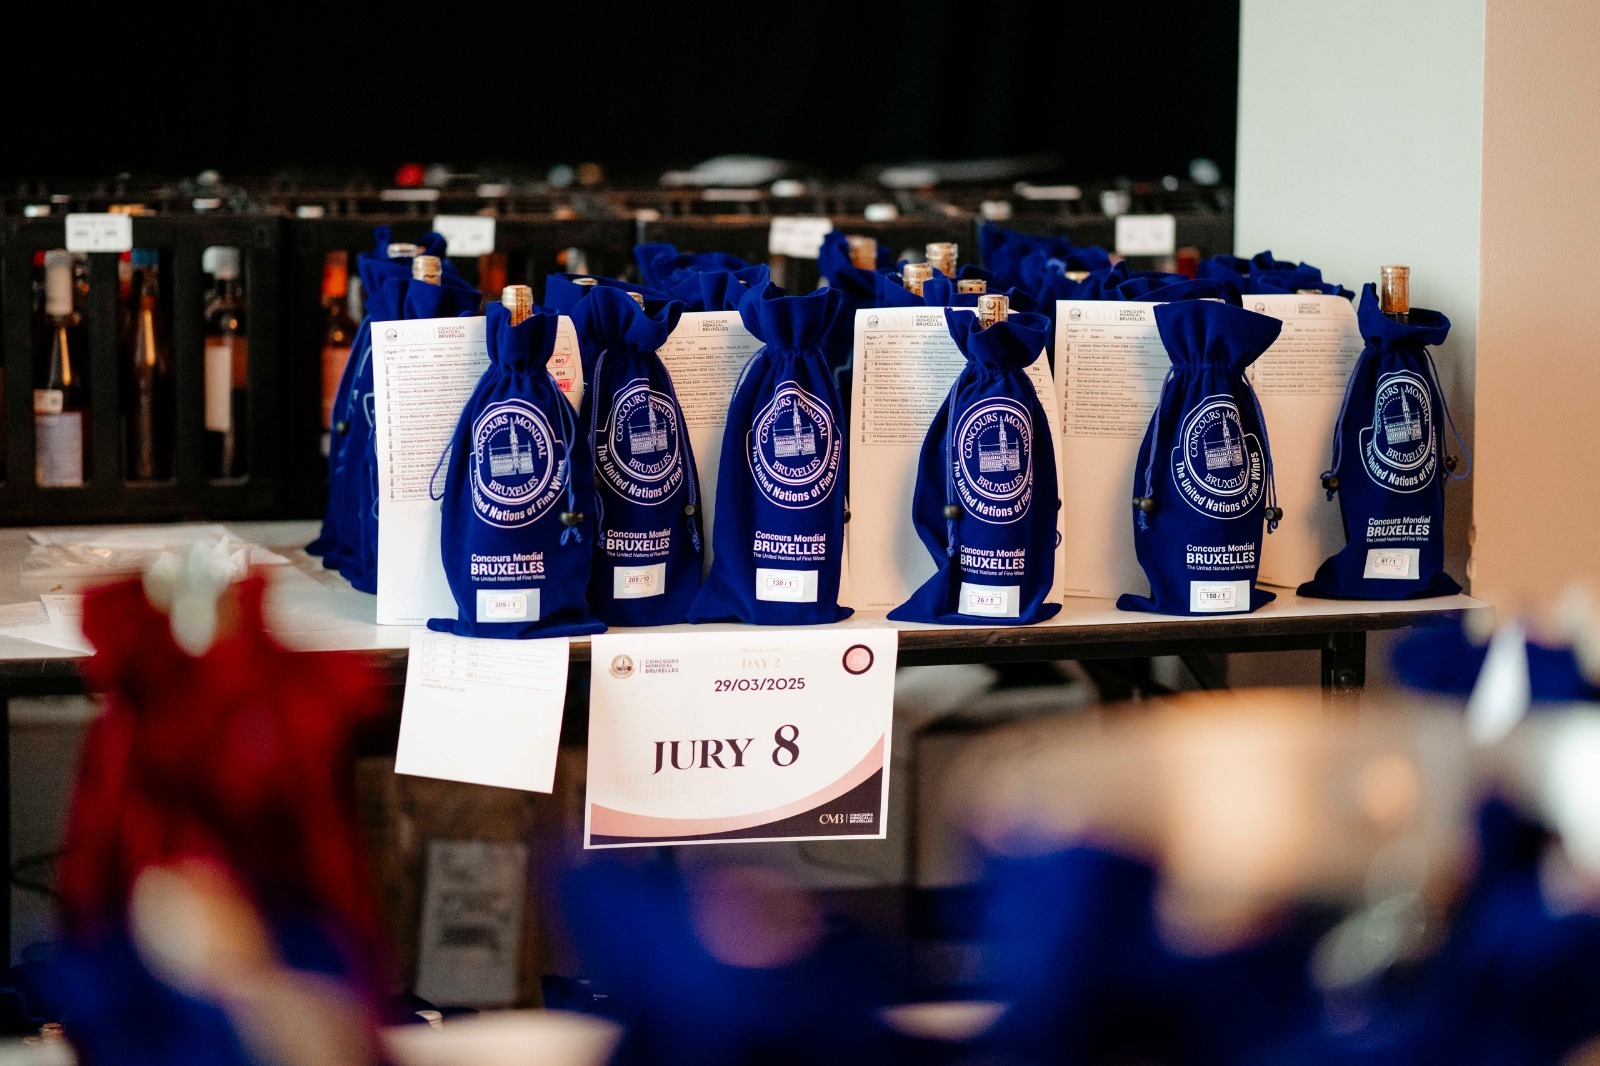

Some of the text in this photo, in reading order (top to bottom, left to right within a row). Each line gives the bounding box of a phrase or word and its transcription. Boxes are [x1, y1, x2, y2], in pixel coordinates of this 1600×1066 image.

[1404, 384, 1430, 425] MONDIAL
[616, 392, 646, 442] CONCOURS
[651, 402, 676, 435] ONDIAL
[478, 414, 509, 465] CONCOURS
[514, 415, 547, 459] MONDIAL
[964, 412, 998, 459] CONCOURS
[1004, 413, 1029, 456] MONDIAL
[1190, 409, 1221, 458] CONCOURS
[1386, 441, 1426, 463] BRUXELLES
[597, 444, 608, 462] The
[604, 461, 630, 491] United
[628, 483, 662, 499] Nations
[664, 482, 671, 493] of
[628, 452, 672, 474] BRUXELLES
[755, 465, 773, 493] United
[772, 487, 810, 502] Nations
[810, 486, 821, 498] of
[819, 471, 834, 491] Fine
[829, 440, 840, 470] Wines
[772, 457, 821, 478] BRUXELLES
[1368, 456, 1389, 480] United
[1388, 472, 1418, 486] Nations
[1419, 469, 1427, 480] of
[488, 476, 539, 497] BRUXELLES
[952, 460, 961, 478] The
[958, 478, 976, 507] United
[976, 500, 1013, 518] Nations
[1014, 500, 1022, 512] of
[976, 473, 1024, 493] BRUXELLES
[1176, 452, 1261, 513] The United Nations of Fine Wines
[1205, 468, 1246, 489] BRUXELLES
[488, 505, 525, 521] Nations
[526, 505, 536, 516] of
[536, 490, 555, 510] Fine
[1366, 524, 1430, 537] BRUXELLES
[1368, 516, 1431, 526] Concours Mondial
[607, 528, 672, 539] Concours Mondial
[755, 530, 826, 542] Concours Mondial
[606, 538, 670, 552] BRUXELLES
[753, 540, 826, 555] BRUXELLES
[960, 545, 1026, 557] Concours Mondial
[1186, 542, 1255, 553] Concours Mondial
[471, 552, 544, 563] Concours Mondial
[960, 554, 1025, 570] BRUXELLES
[1186, 552, 1255, 565] BRUXELLES
[471, 562, 545, 575] BRUXELLES
[742, 658, 781, 669] DAY 2
[714, 678, 806, 691] 29/03/2025
[652, 724, 800, 775] JURY 8
[819, 814, 843, 824] CMB
